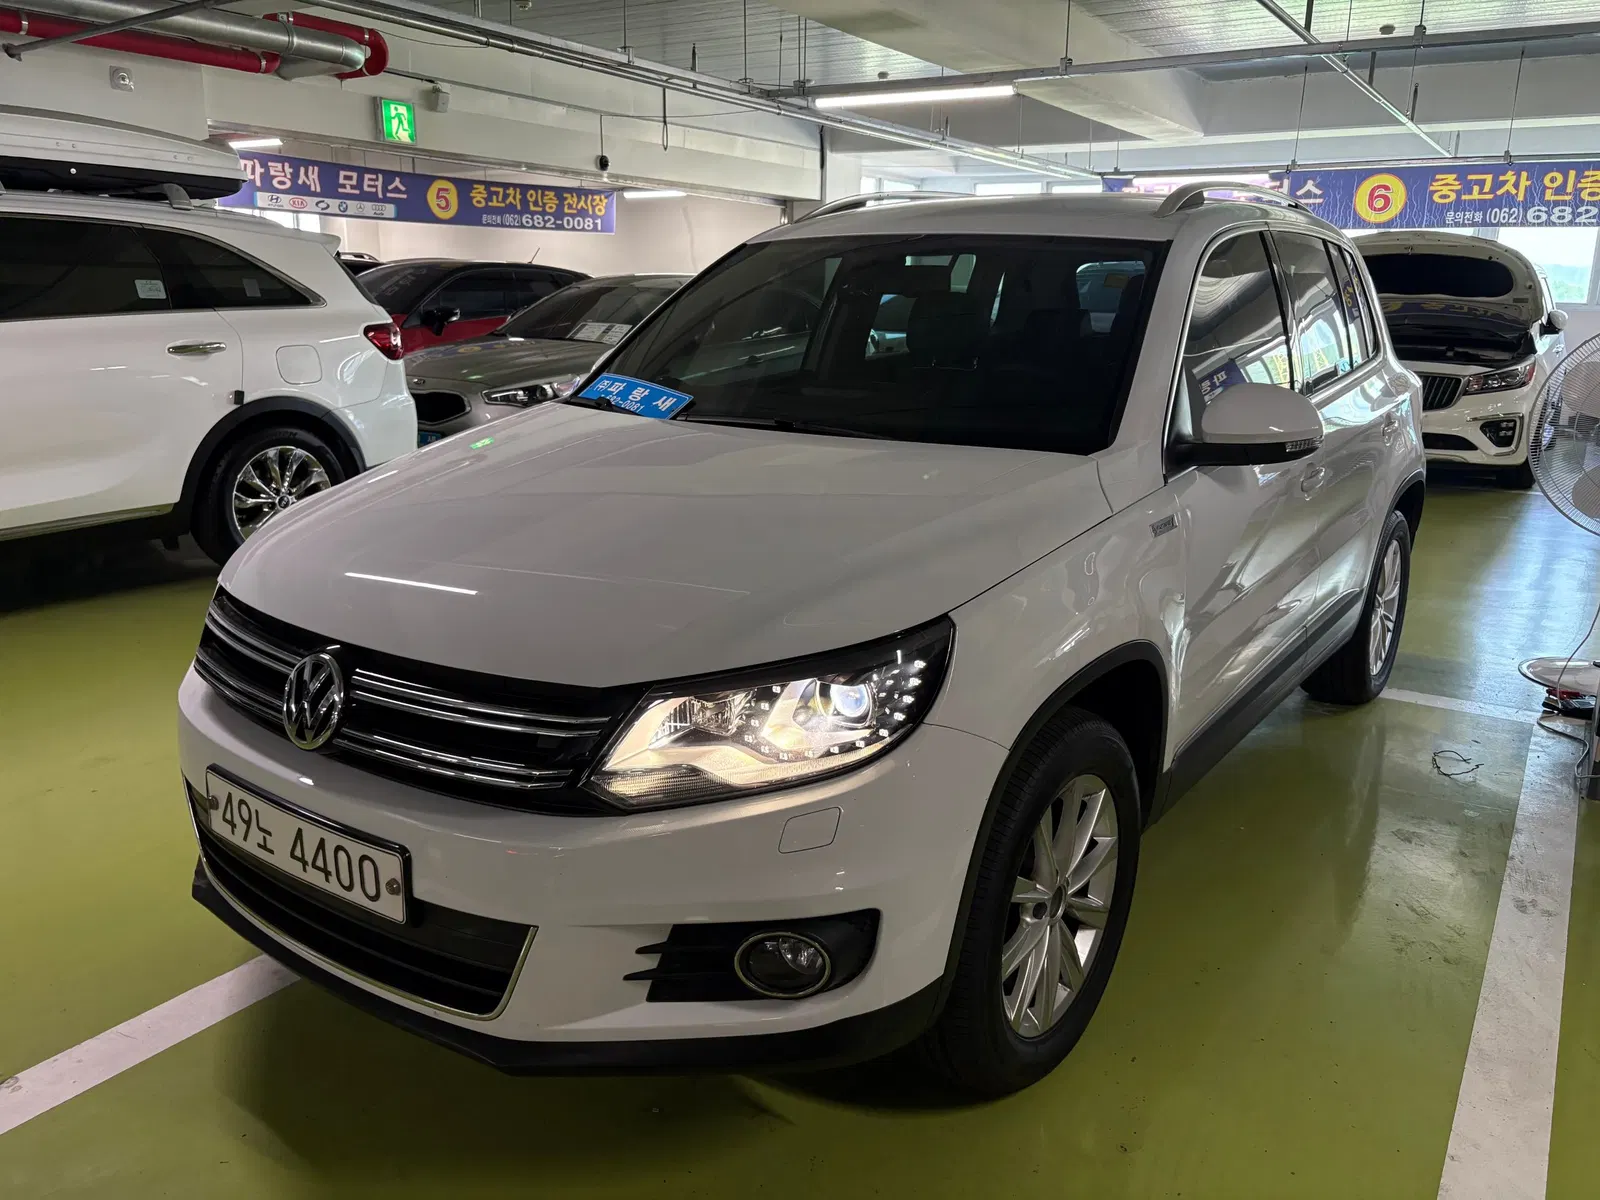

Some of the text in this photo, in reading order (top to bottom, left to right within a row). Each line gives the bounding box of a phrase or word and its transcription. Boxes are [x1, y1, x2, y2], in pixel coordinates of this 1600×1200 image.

[240, 158, 408, 199] 파랑새 모터스
[1429, 169, 1600, 204] 중고차 인증
[434, 187, 452, 212] 5
[470, 184, 608, 216] 중고차 인증 전시장
[1367, 183, 1393, 214] 6
[1445, 210, 1483, 224] 문의전화
[222, 791, 381, 902] 49노 4400
